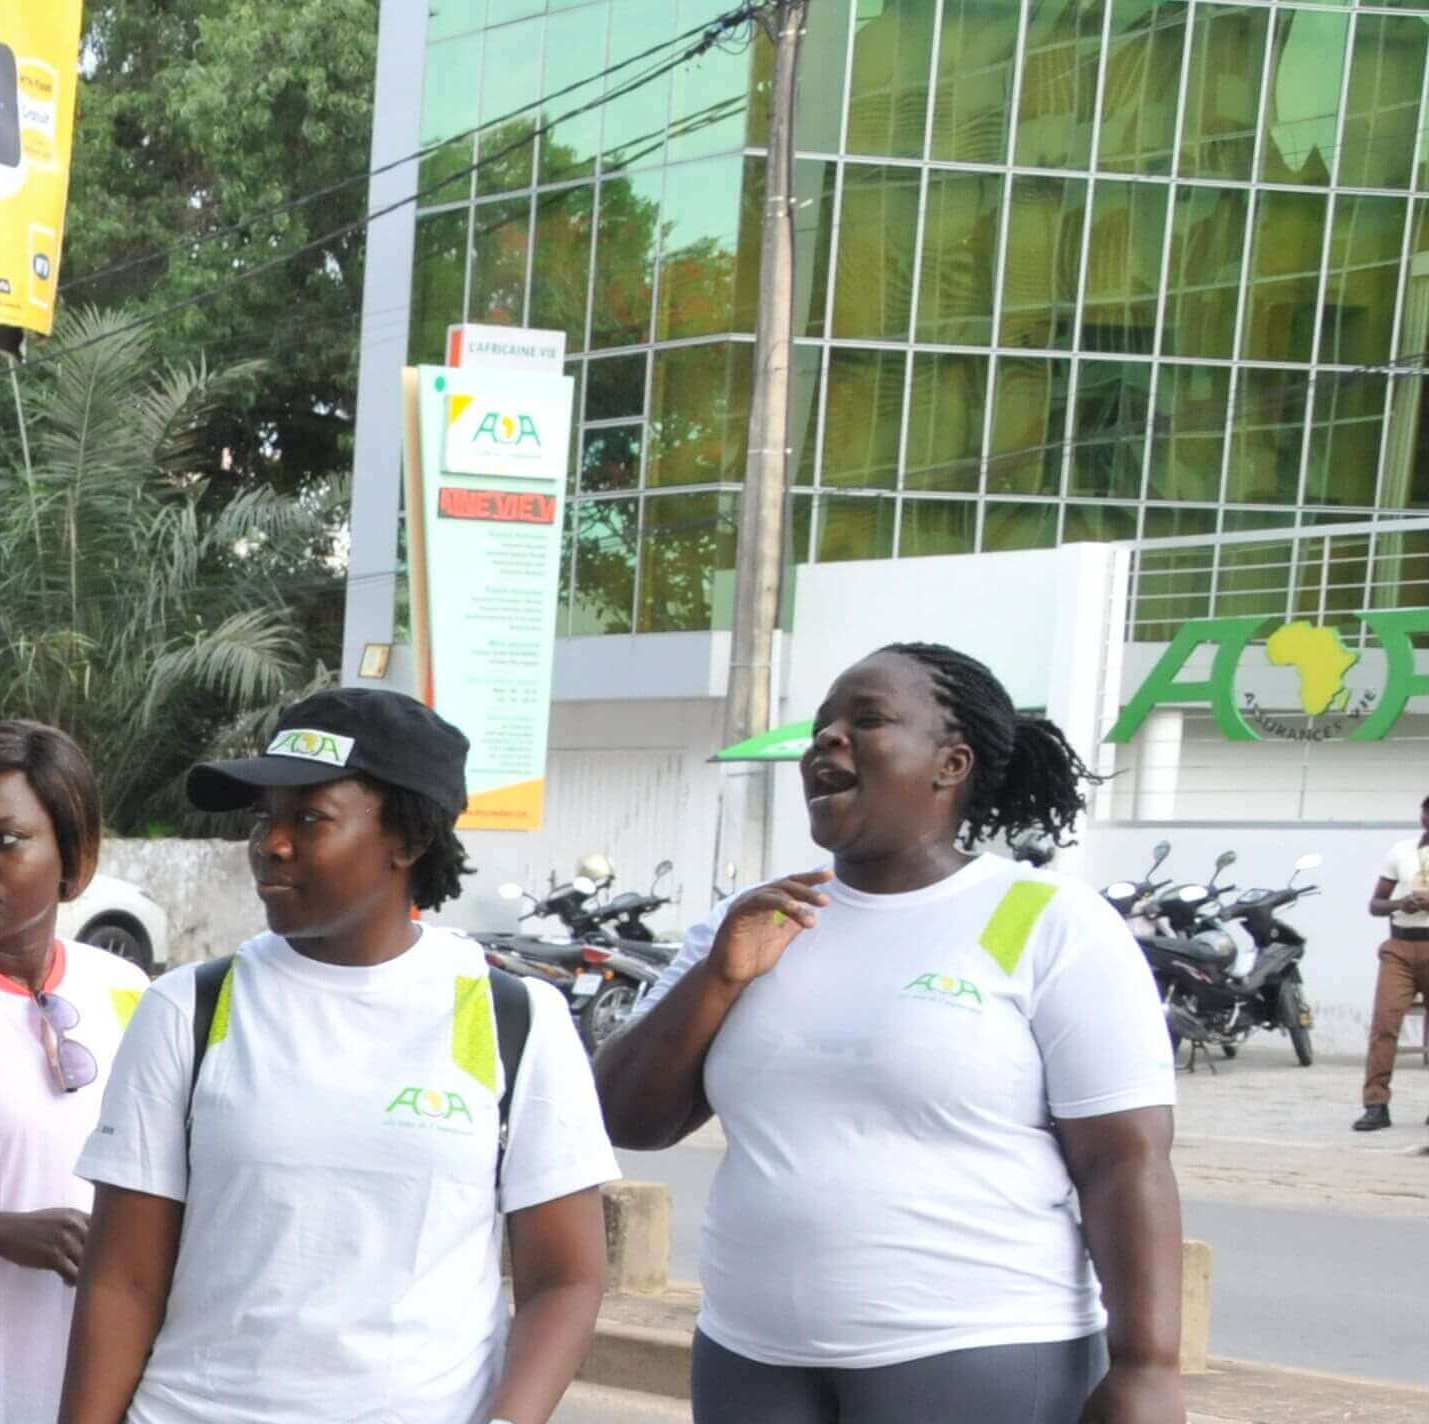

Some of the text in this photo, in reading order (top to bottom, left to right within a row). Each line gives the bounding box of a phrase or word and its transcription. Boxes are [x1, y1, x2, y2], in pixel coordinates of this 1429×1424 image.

[469, 341, 556, 359] L'AFRICAINE VIE
[1244, 690, 1376, 741] ASSURANCES VIE
